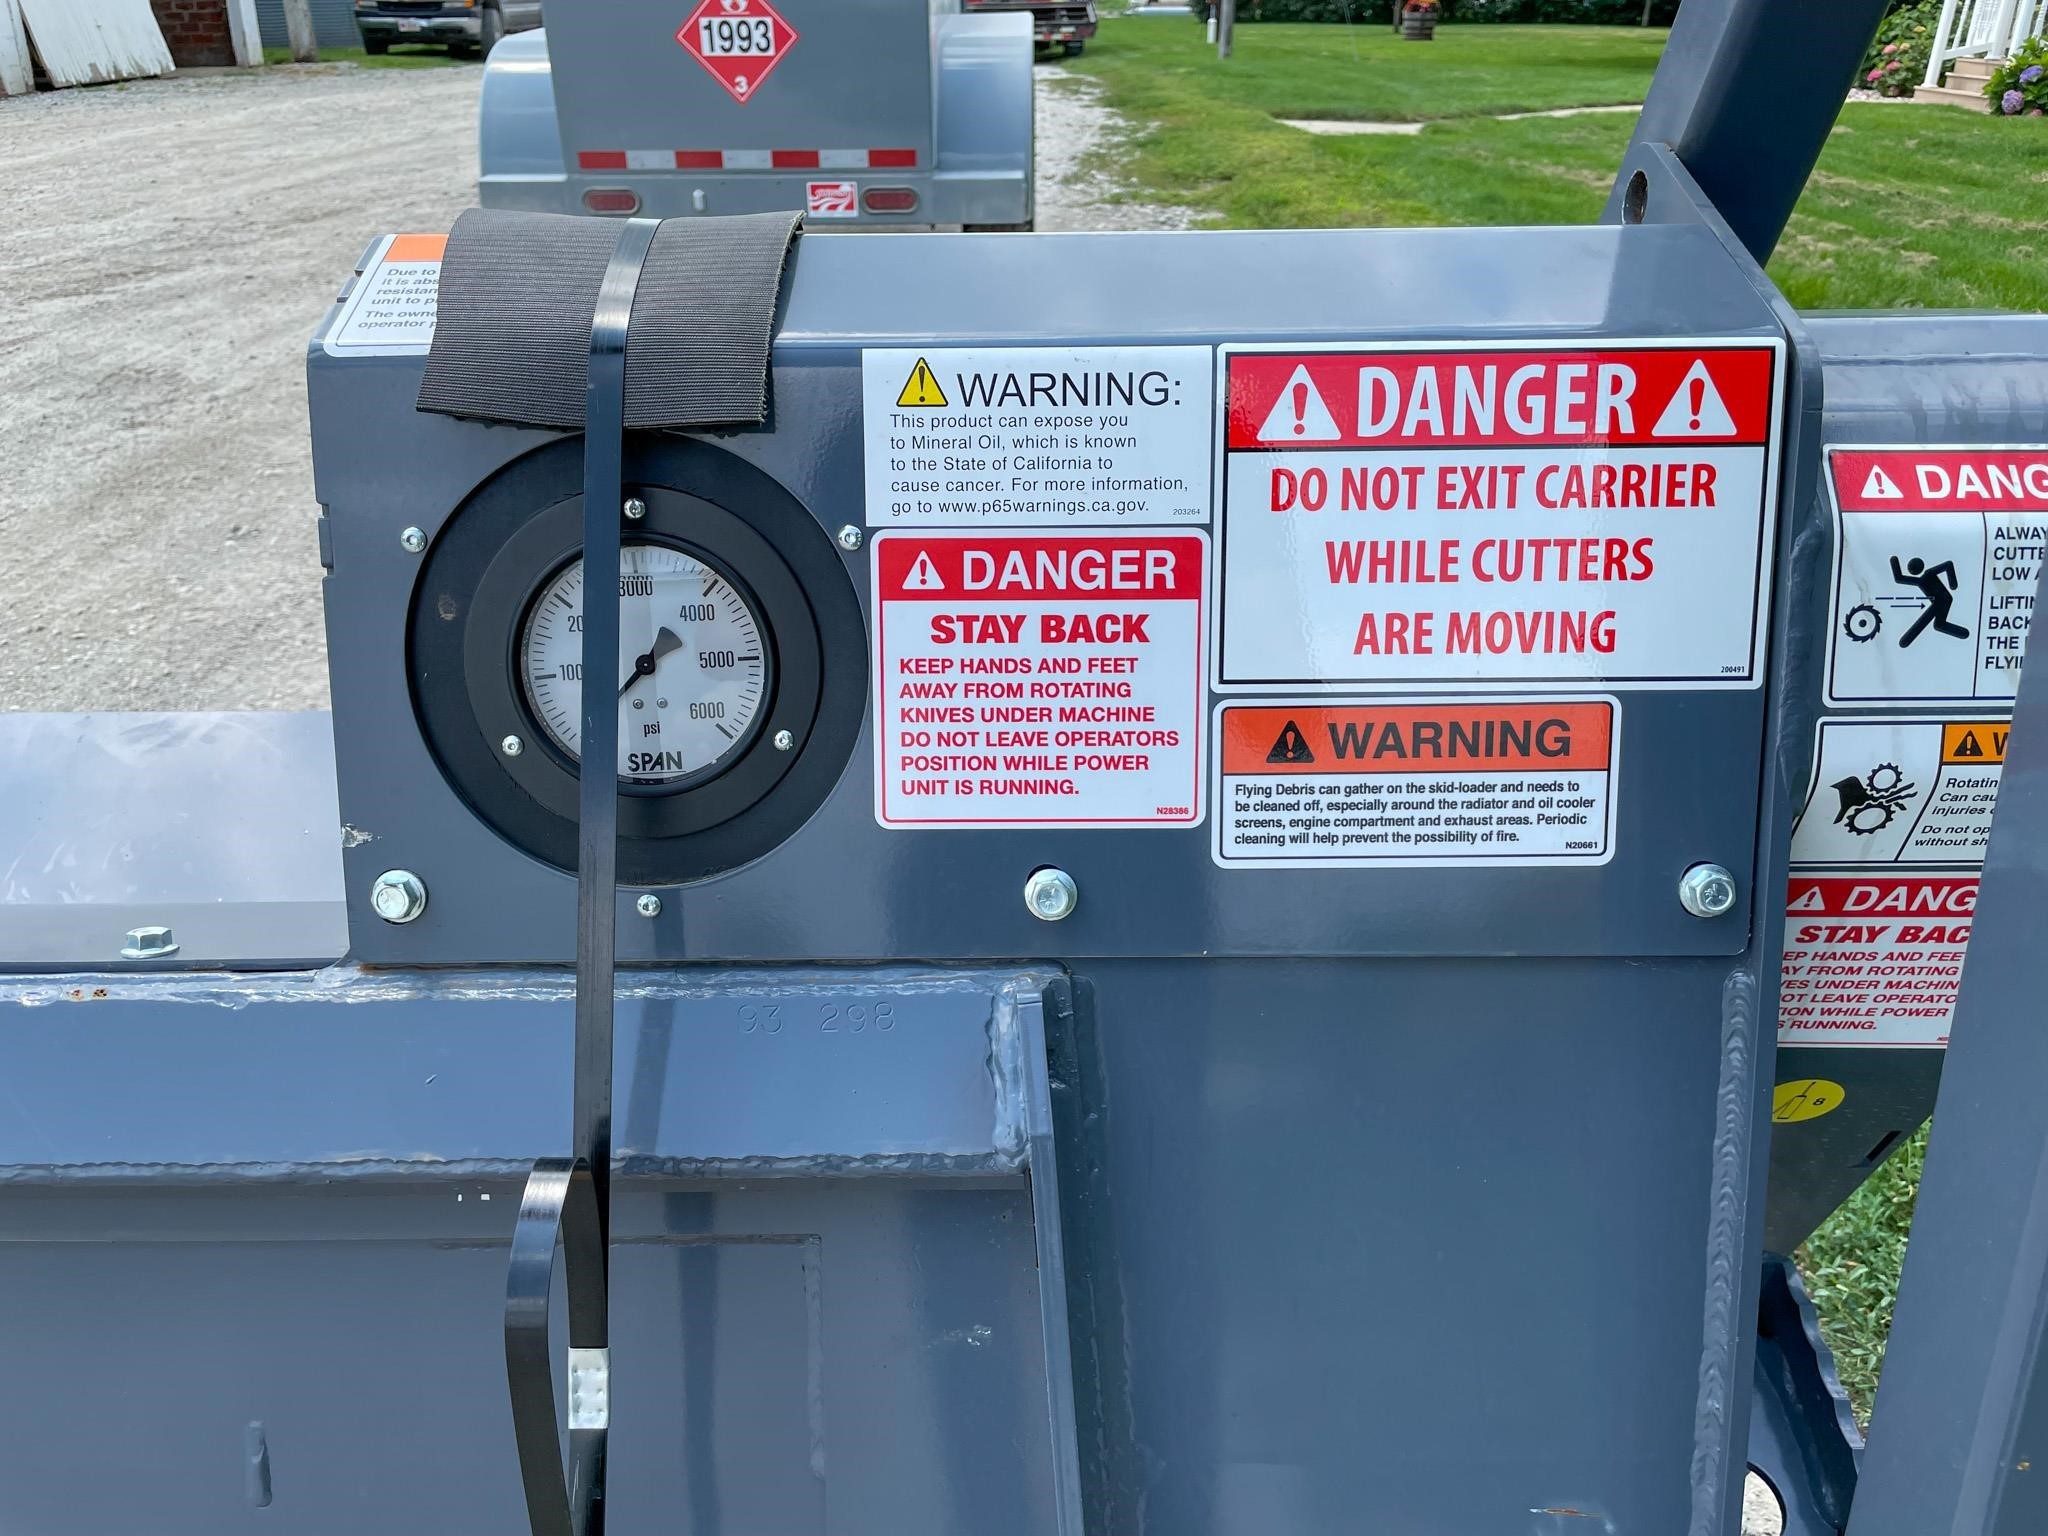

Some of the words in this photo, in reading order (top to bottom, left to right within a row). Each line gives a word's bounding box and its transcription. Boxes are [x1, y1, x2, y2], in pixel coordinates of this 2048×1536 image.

[704, 20, 770, 53] 1993
[735, 75, 748, 93] 3
[358, 321, 426, 329] operator
[957, 372, 1180, 407] WARNING:
[1358, 364, 1636, 437] DANGER
[890, 414, 924, 427] This
[932, 414, 992, 431] product
[999, 417, 1027, 427] can
[1034, 416, 1092, 430] expose
[1100, 416, 1127, 430] you
[891, 437, 905, 449] to
[913, 436, 971, 449] Mineral
[979, 435, 1004, 450] Oil,
[1012, 435, 1058, 448] which
[1066, 435, 1078, 448] is
[1085, 435, 1136, 448] known
[891, 458, 905, 470] to
[912, 457, 936, 470] the
[944, 457, 985, 470] State
[993, 457, 1007, 470] of
[1014, 456, 1092, 470] California
[1098, 457, 1112, 469] to
[892, 482, 939, 492] cause
[946, 481, 1003, 491] cancer.
[1012, 478, 1038, 491] For
[1045, 481, 1085, 490] more
[1092, 476, 1187, 491] information,
[1271, 468, 1327, 512] DO
[1341, 467, 1425, 510] NOT
[1437, 466, 1525, 509] EXIT
[1536, 464, 1716, 508] CARRIER
[1915, 464, 2048, 498] DANG
[892, 503, 911, 516] go
[918, 501, 932, 513] to
[939, 499, 1149, 516] www.p65warnings.ca.gov.
[1994, 527, 2047, 540] ALWAY
[1325, 540, 1459, 583] WHILE
[1472, 538, 1653, 582] CUTTERS
[1994, 547, 2044, 560] CUTTE
[964, 550, 1175, 590] DANGER
[1992, 567, 2030, 580] LOW
[1990, 597, 2035, 609] LIFTI
[680, 604, 715, 621] 4000
[931, 615, 1027, 644] STAY
[1041, 614, 1150, 643] BACK
[1354, 613, 1433, 654] ARE
[1446, 611, 1616, 654] MOVING
[1987, 636, 2019, 649] THE
[700, 651, 734, 668] 5000
[900, 659, 953, 674] KEEP
[961, 658, 1031, 673] HANDS
[1038, 658, 1081, 673] AND
[1088, 658, 1138, 673] FEET
[1985, 657, 2023, 669] FLYI
[560, 664, 582, 680] 100
[900, 683, 958, 698] AWAY
[964, 683, 1023, 698] FROM
[1031, 682, 1131, 698] ROTATING
[690, 702, 724, 719] 6000
[901, 707, 974, 723] KNIVES
[981, 707, 1052, 722] UNDER
[1059, 707, 1154, 722] MACHINE
[644, 721, 660, 737] psi
[901, 732, 930, 747] DO
[938, 732, 979, 747] NOT
[986, 732, 1048, 746] LEAVE
[1055, 731, 1179, 746] OPERATORS
[1328, 719, 1570, 759] WARNING
[627, 751, 684, 772] SPAN
[902, 756, 996, 771] POSITION
[1003, 756, 1067, 770] WHILE
[1075, 755, 1148, 770] POWER
[902, 780, 949, 795] UNIT
[956, 780, 973, 795] IS
[980, 779, 1079, 794] RUNNING.
[1236, 784, 1272, 798] Flying
[1276, 784, 1315, 795] Debris
[1319, 784, 1342, 795] can
[1344, 783, 1383, 797] gather
[1387, 785, 1402, 794] on
[1406, 782, 1425, 793] the
[1429, 781, 1497, 793] skid-loader
[1500, 781, 1523, 792] and
[1527, 781, 1564, 792] needs
[1568, 781, 1579, 792] to
[1946, 778, 1998, 788] Rotatin
[1235, 801, 1250, 812] be
[1253, 800, 1300, 812] cleaned
[1304, 800, 1323, 813] off,
[1327, 799, 1388, 814] especially
[1391, 798, 1434, 810] around
[1438, 798, 1458, 809] the
[1461, 798, 1509, 809] radiator
[1512, 797, 1534, 808] and
[1538, 797, 1553, 808] oil
[1557, 797, 1595, 808] cooler
[1940, 793, 1968, 802] Can
[1972, 793, 1995, 801] cau
[1932, 806, 1986, 816] injuries
[1235, 819, 1285, 829] screens,
[1289, 816, 1330, 830] engine
[1334, 816, 1415, 830] compartment
[1418, 815, 1440, 826] and
[1444, 815, 1493, 826] exhaust
[1496, 816, 1533, 825] areas.
[1537, 813, 1587, 824] Periodic
[1235, 833, 1285, 847] cleaning
[1289, 832, 1309, 843] will
[1313, 832, 1339, 846] help
[1343, 832, 1388, 846] prevent
[1392, 832, 1411, 842] the
[1415, 831, 1477, 845] possibility
[1481, 830, 1493, 841] of
[1496, 830, 1519, 841] fire.
[1915, 838, 1968, 846] without
[1842, 886, 1979, 911] DANG
[1795, 926, 1890, 943] STAY
[1895, 925, 1971, 943] BAC
[1811, 952, 1878, 961] HANDS
[1881, 952, 1923, 961] AND
[1927, 952, 1965, 960] FEE
[1806, 966, 1863, 975] FROM
[1867, 966, 1959, 975] ROTATING
[1814, 980, 1880, 989] UNDER
[1884, 981, 1959, 990] MACHIN
[1810, 994, 1869, 1003] LEAVE
[1873, 994, 1957, 1003] OPERATO
[820, 1002, 895, 1033] 298
[1820, 1008, 1878, 1016] WHILE
[1881, 1008, 1949, 1016] POWER
[1790, 1021, 1877, 1029] RUNNING.
